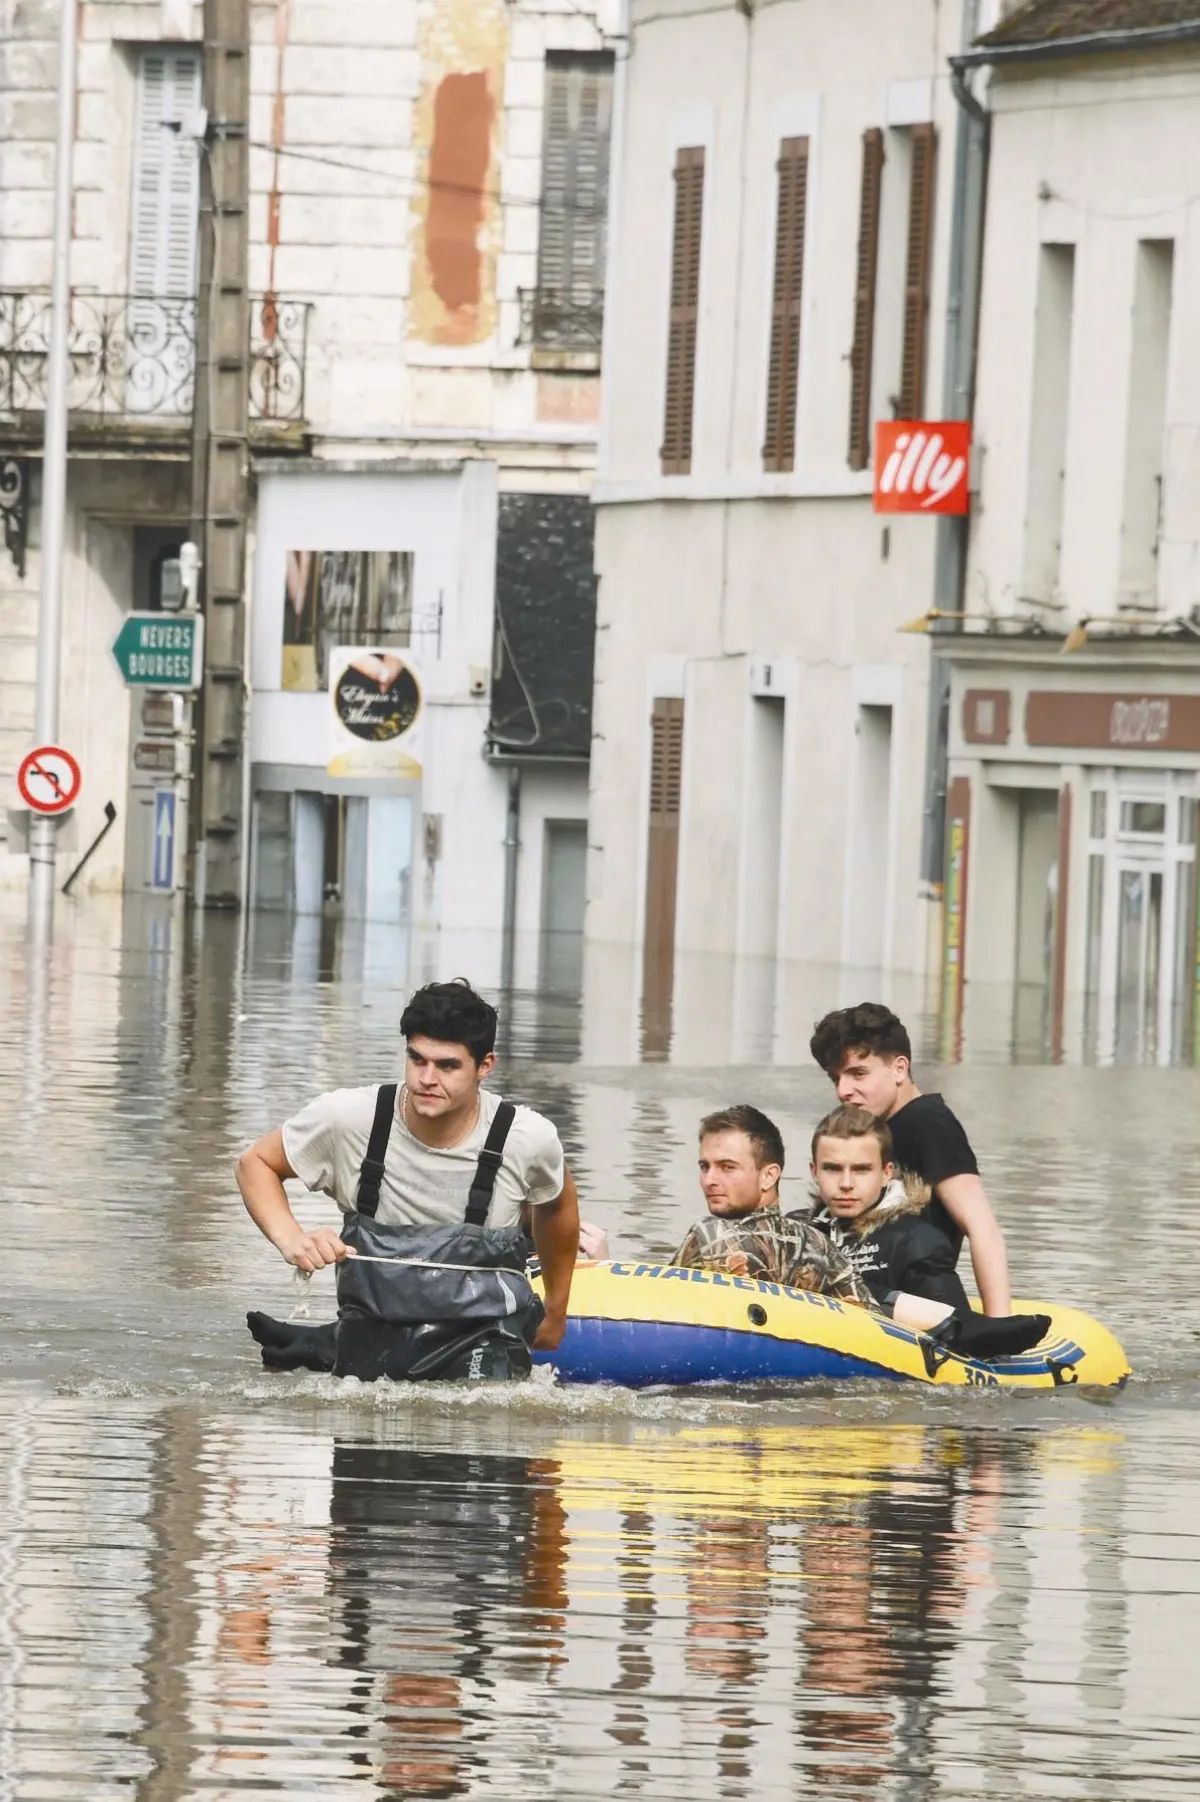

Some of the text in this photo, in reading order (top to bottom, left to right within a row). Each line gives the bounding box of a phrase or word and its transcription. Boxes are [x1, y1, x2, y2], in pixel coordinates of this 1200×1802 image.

[880, 431, 965, 507] illy
[140, 624, 191, 649] NEVERS
[128, 652, 190, 678] BOURGES
[609, 1262, 846, 1316] CHALLENGER
[964, 1366, 999, 1386] 300
